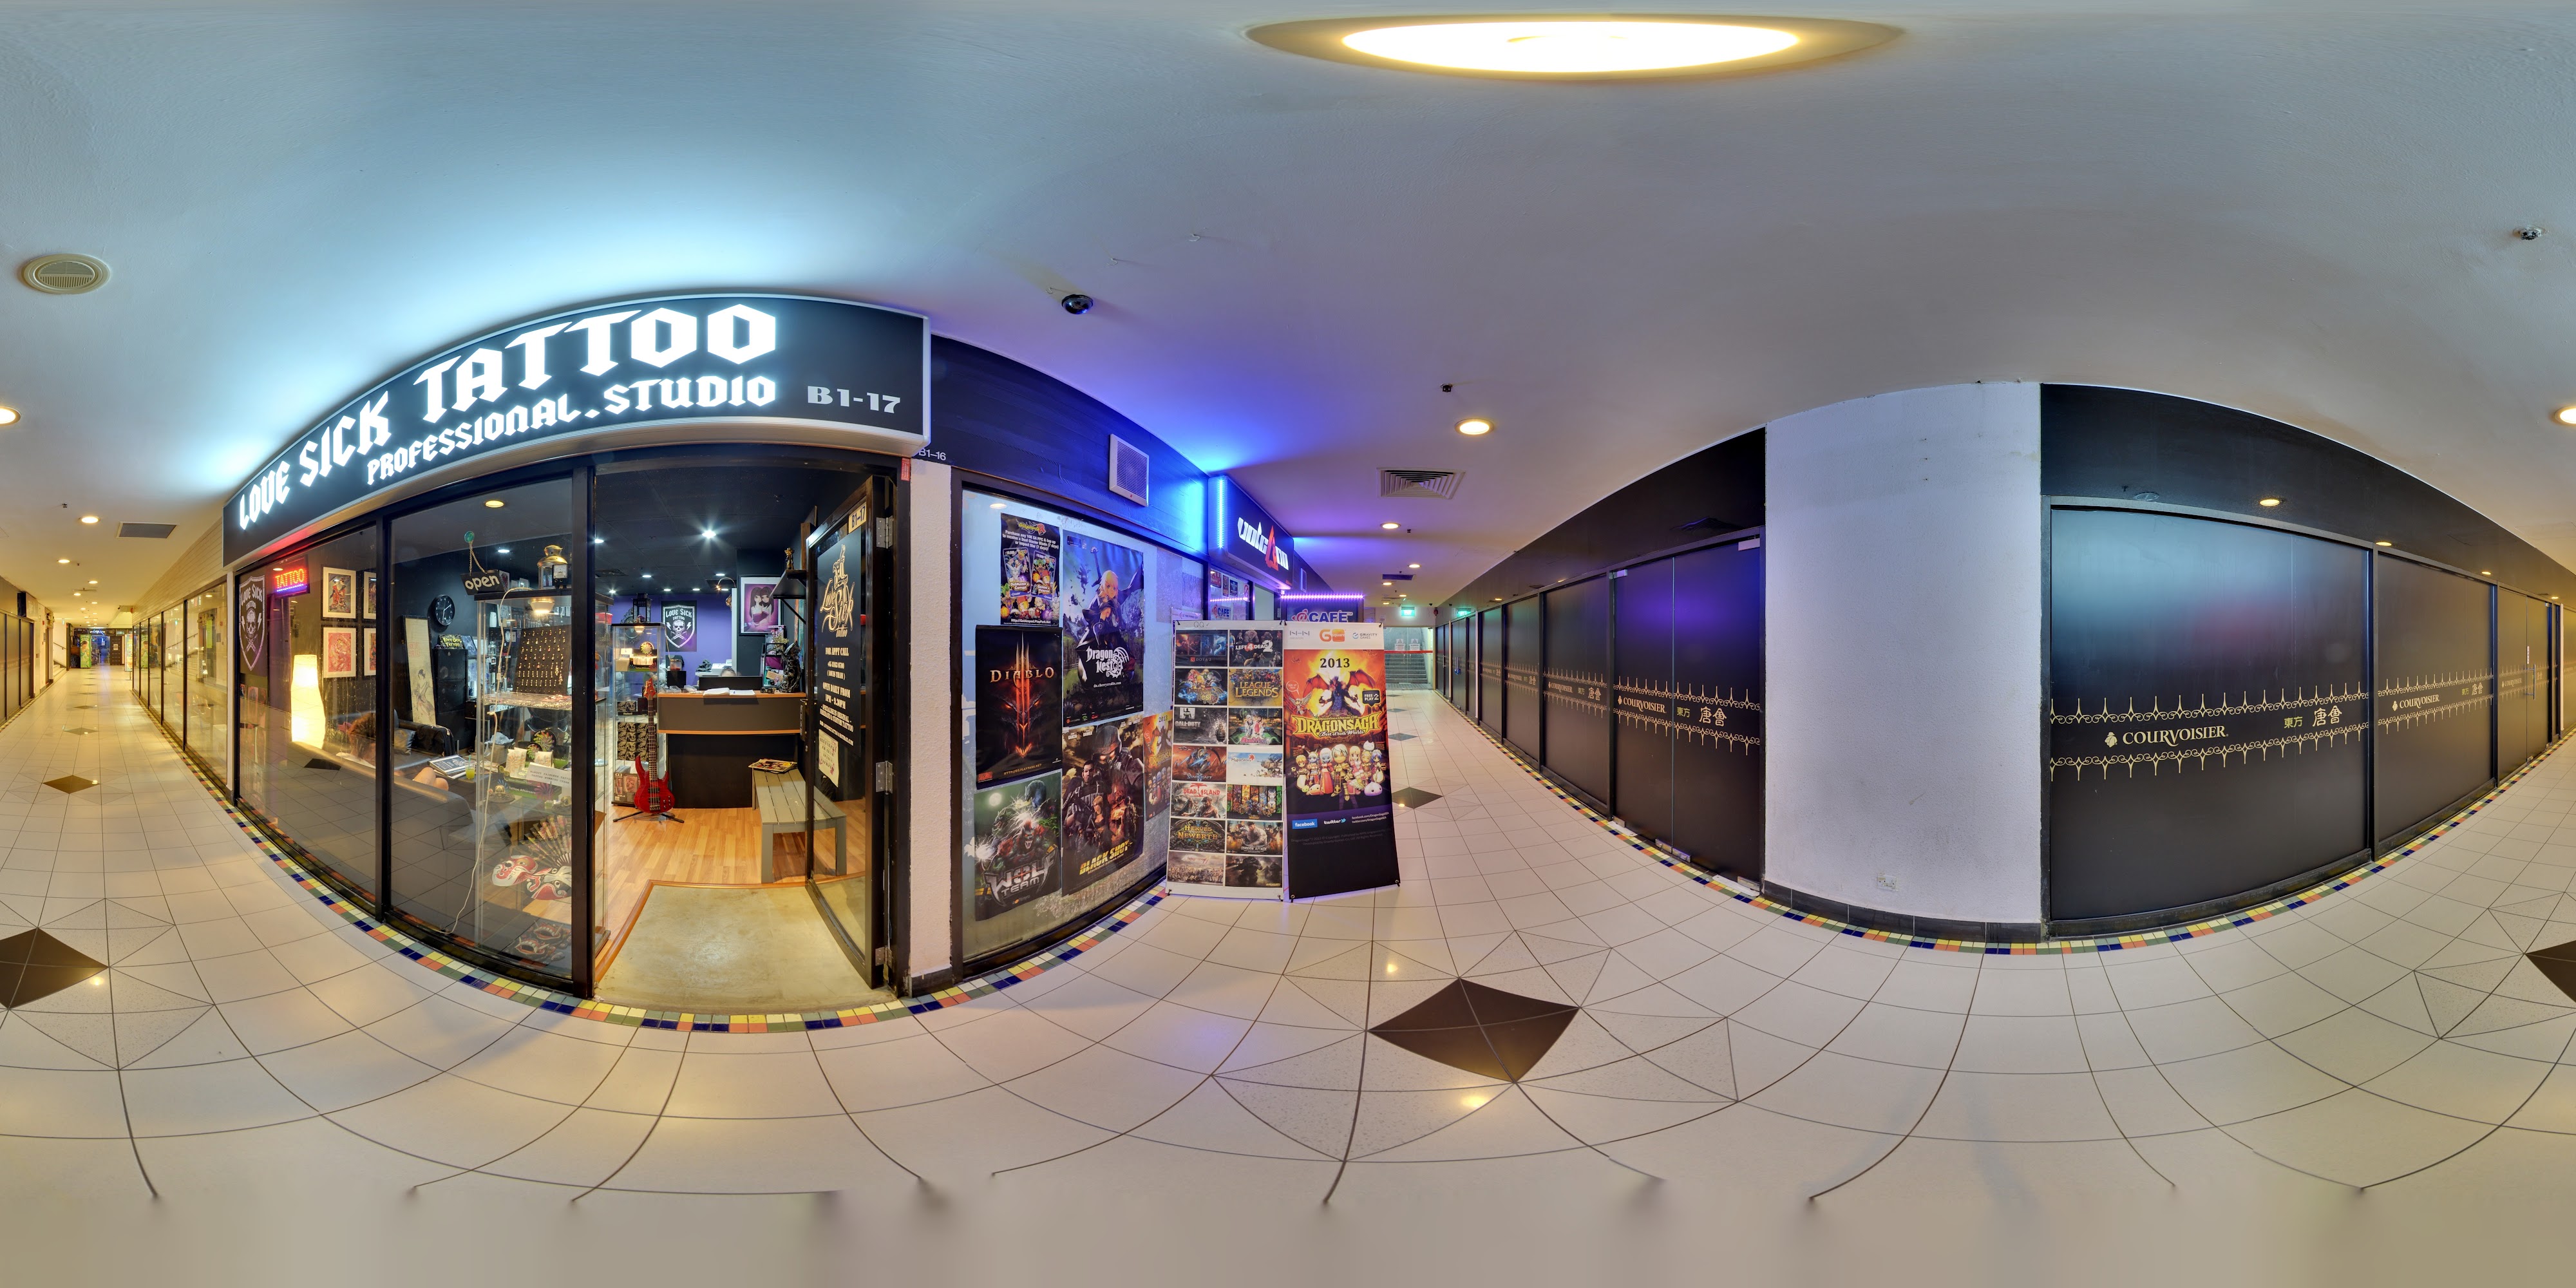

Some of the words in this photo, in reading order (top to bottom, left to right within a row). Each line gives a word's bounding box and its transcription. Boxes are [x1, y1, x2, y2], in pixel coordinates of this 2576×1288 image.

[299, 390, 392, 488] SICK
[413, 304, 775, 423] TATTOO
[808, 386, 901, 413] B1-17
[919, 448, 946, 460] B1-16
[851, 506, 866, 528] B1-17
[275, 569, 305, 588] TATTOO
[465, 575, 500, 591] open
[1086, 646, 1113, 662] Dragon
[1095, 659, 1113, 673] Nest
[1320, 658, 1350, 668] 2013
[990, 667, 1054, 687] DIABLO
[840, 687, 851, 698] FROM
[1235, 687, 1279, 697] LEGENDS
[1624, 697, 1665, 713] COURVOISIER
[2400, 694, 2439, 708] COURVOISIER
[1677, 707, 1690, 718] 東方
[1292, 712, 1382, 737] DRAGONSAGA
[2284, 716, 2303, 728] 東方
[2123, 726, 2226, 746] COURVOISIER
[1079, 851, 1109, 875] BLACK
[1110, 839, 1130, 860] SHOT
[985, 850, 1056, 902] WOLF
[1001, 876, 1039, 896] TEAM
